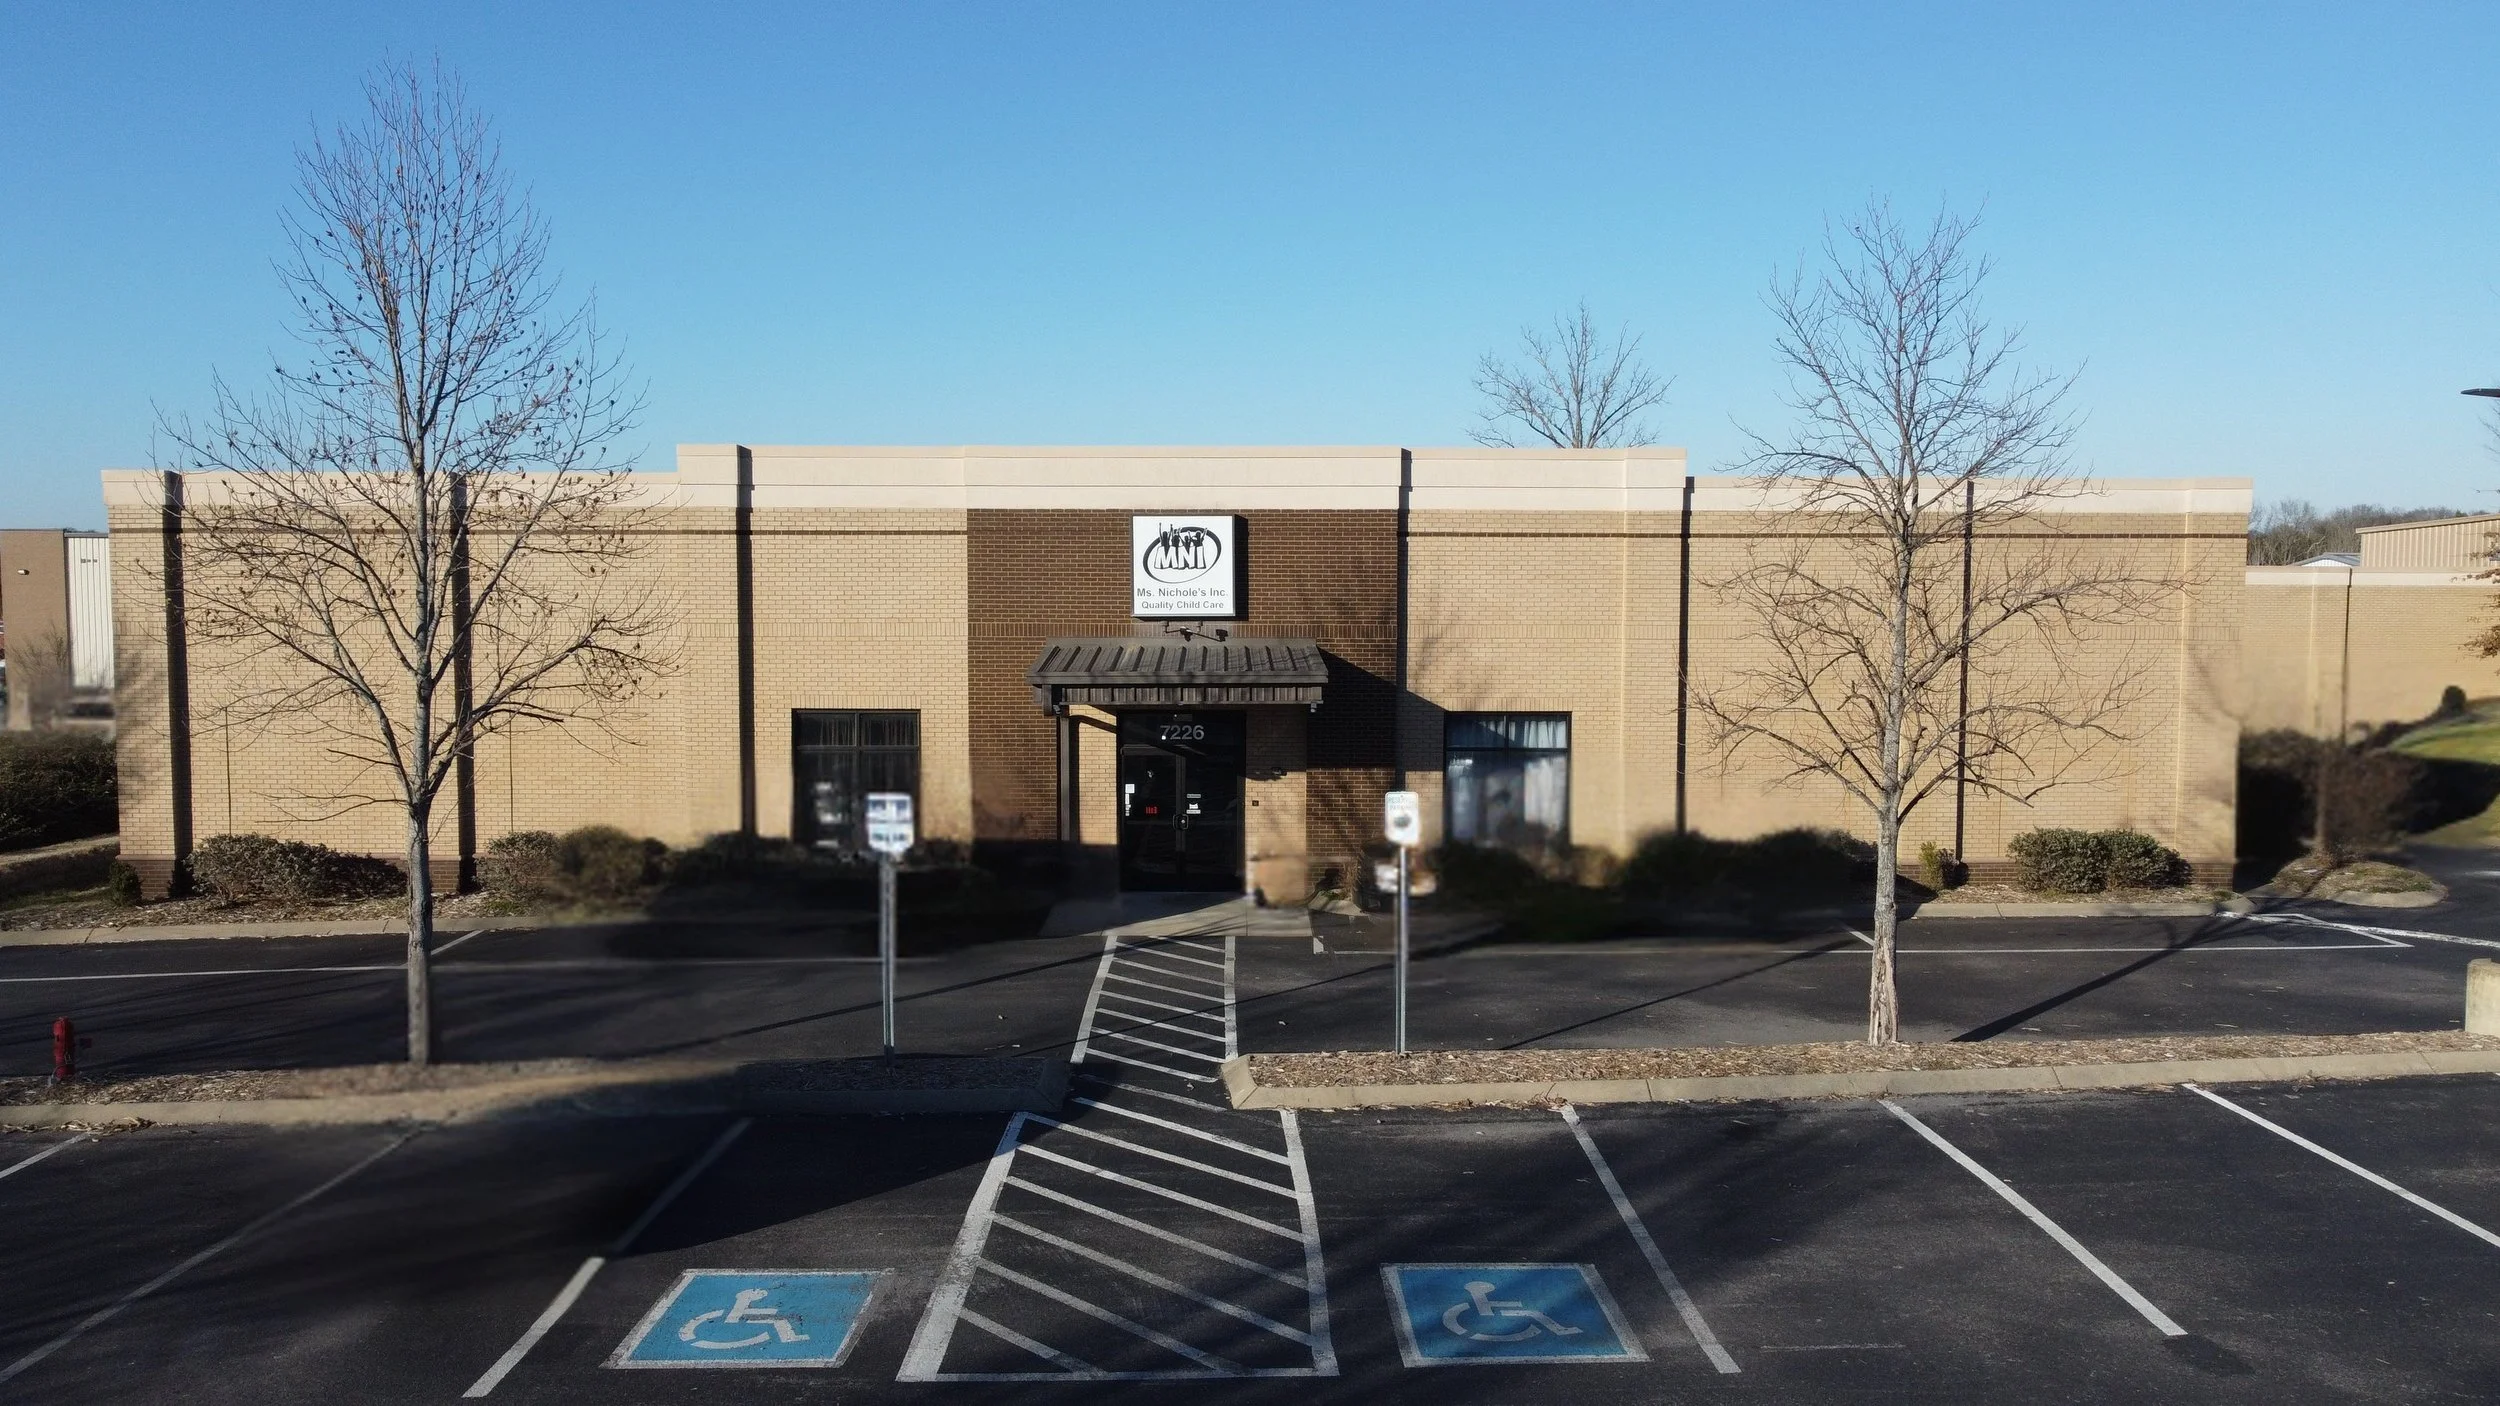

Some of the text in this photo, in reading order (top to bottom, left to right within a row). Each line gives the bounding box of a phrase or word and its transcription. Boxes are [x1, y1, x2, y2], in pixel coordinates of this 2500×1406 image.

[1154, 545, 1207, 570] MNI
[1137, 588, 1229, 597] Ms. Nichole's Inc.
[1141, 601, 1225, 611] Quality Child Care
[1160, 724, 1205, 740] 7226
